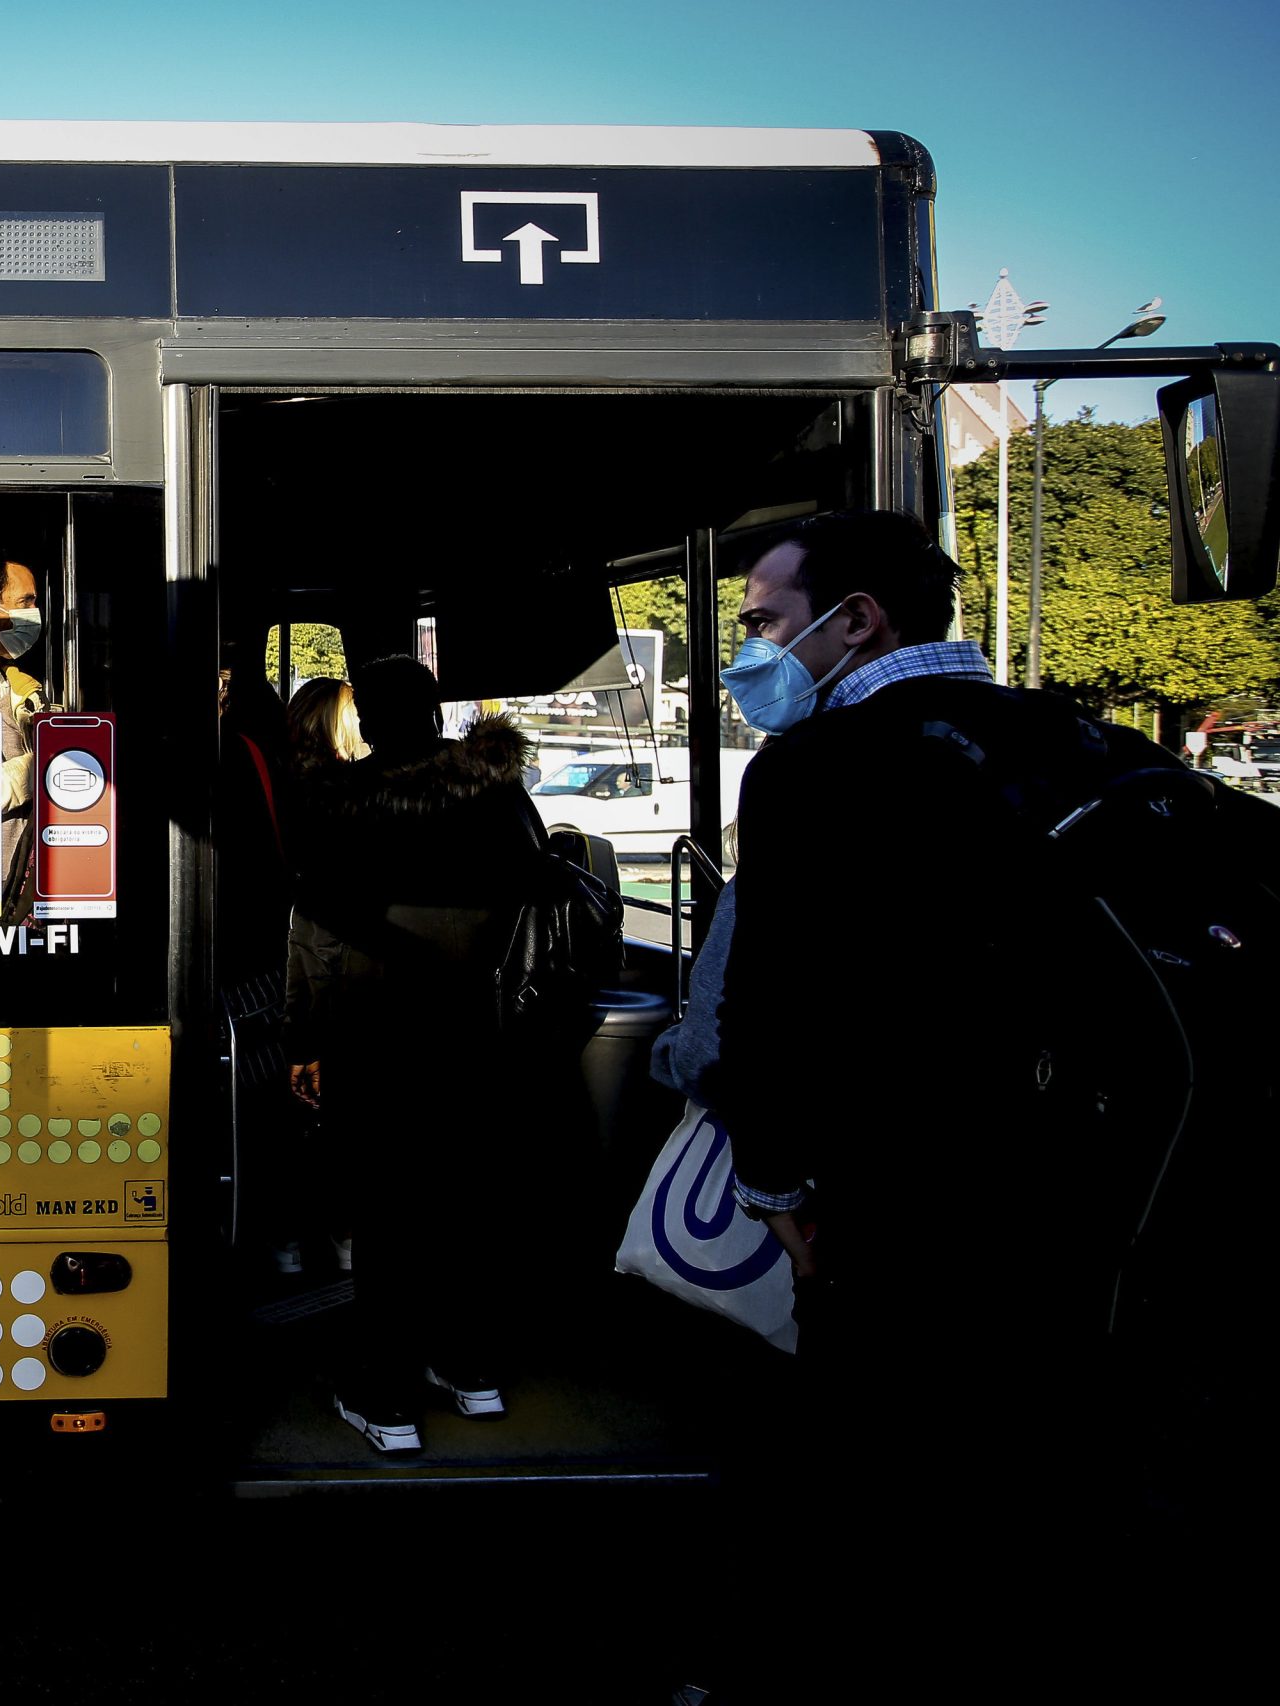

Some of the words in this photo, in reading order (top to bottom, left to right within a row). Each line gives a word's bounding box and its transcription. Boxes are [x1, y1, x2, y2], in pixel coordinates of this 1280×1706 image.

[36, 1201, 76, 1215] MAN
[83, 1200, 118, 1214] 2KD
[42, 1319, 64, 1351] ABERTURA
